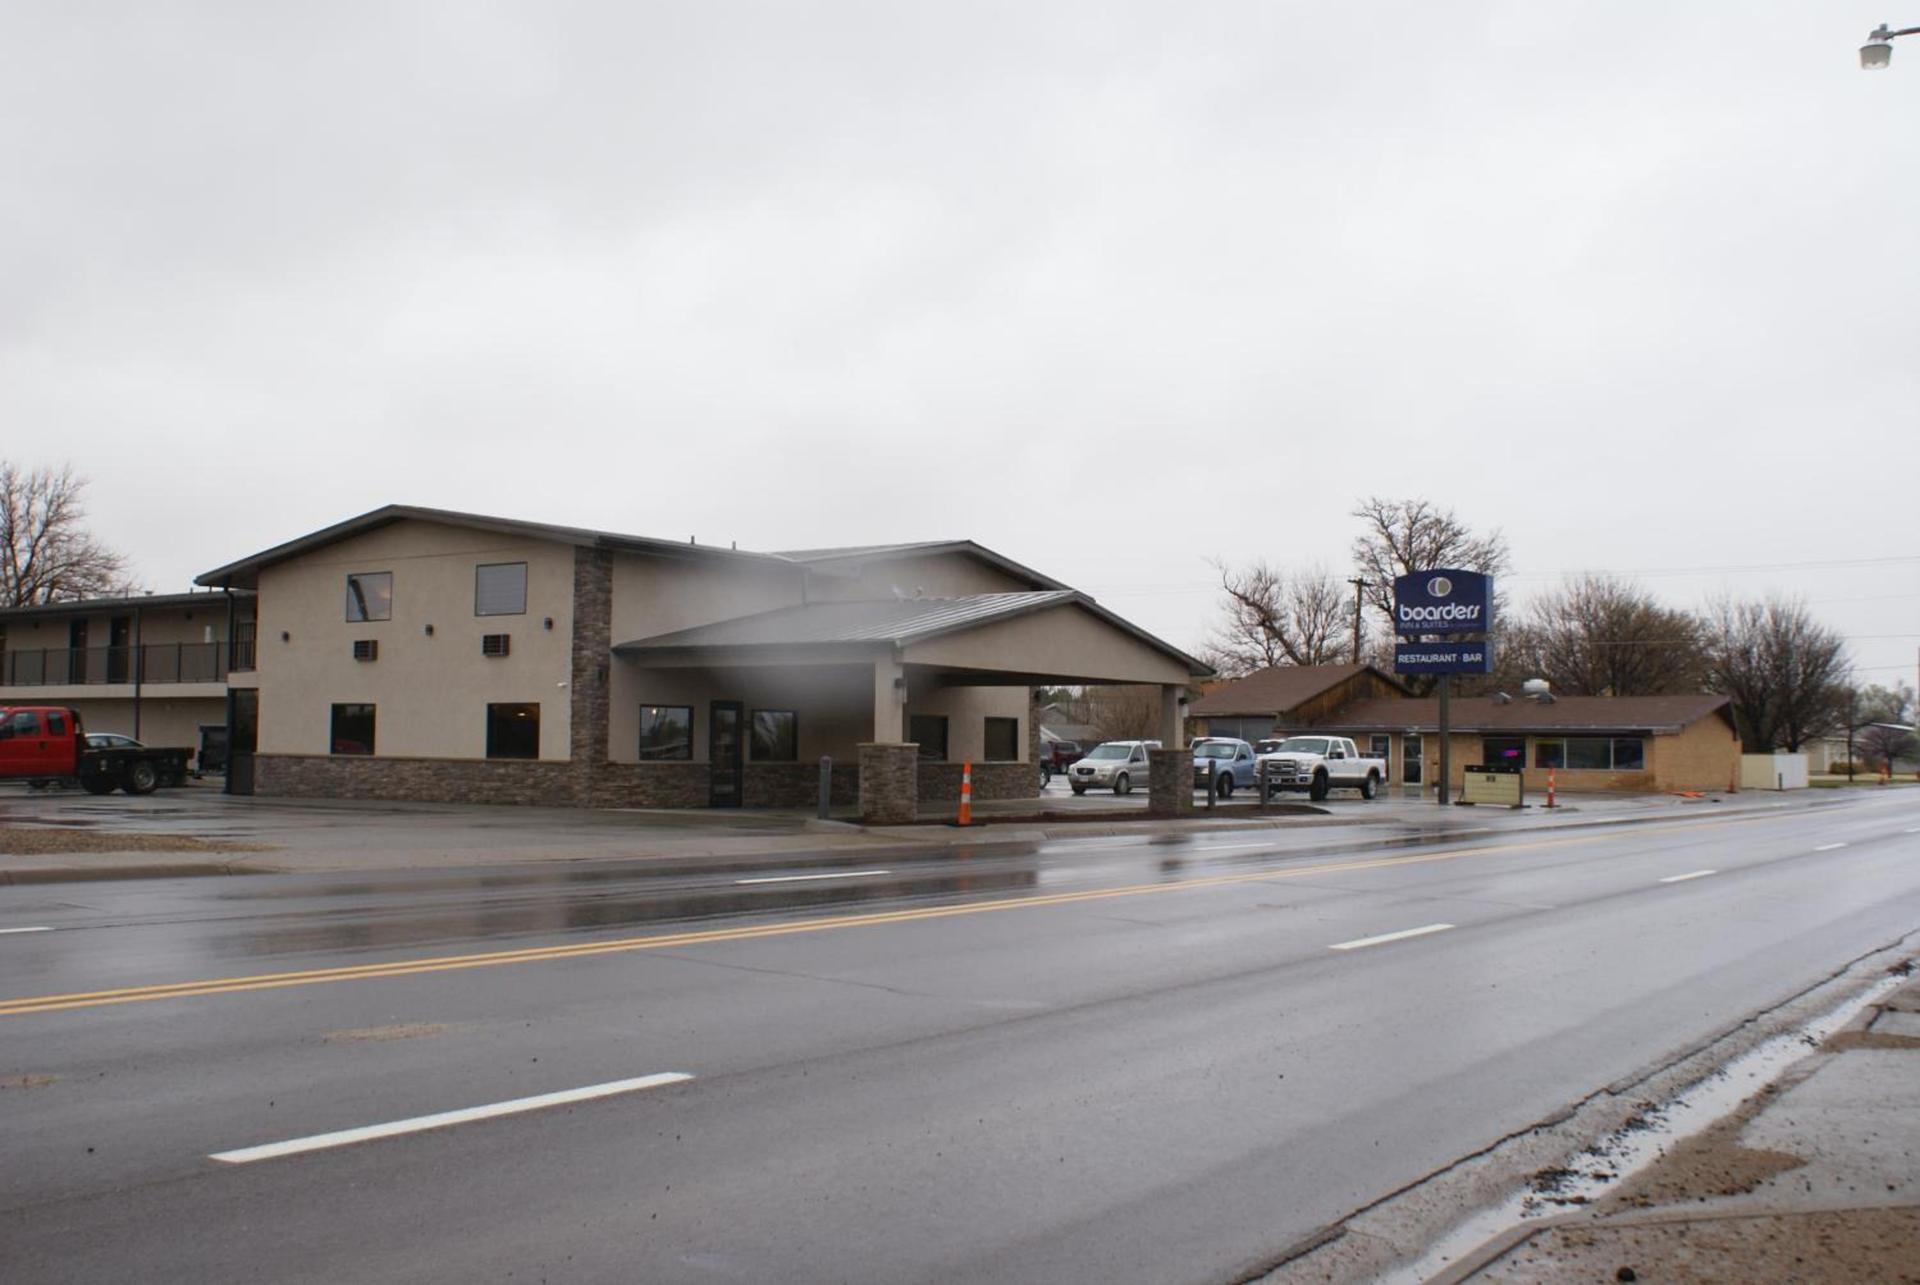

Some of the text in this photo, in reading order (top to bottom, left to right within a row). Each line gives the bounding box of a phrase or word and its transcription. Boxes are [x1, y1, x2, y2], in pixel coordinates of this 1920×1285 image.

[1400, 602, 1480, 621] boarders
[1398, 653, 1482, 663] RESTAURANT BAR
